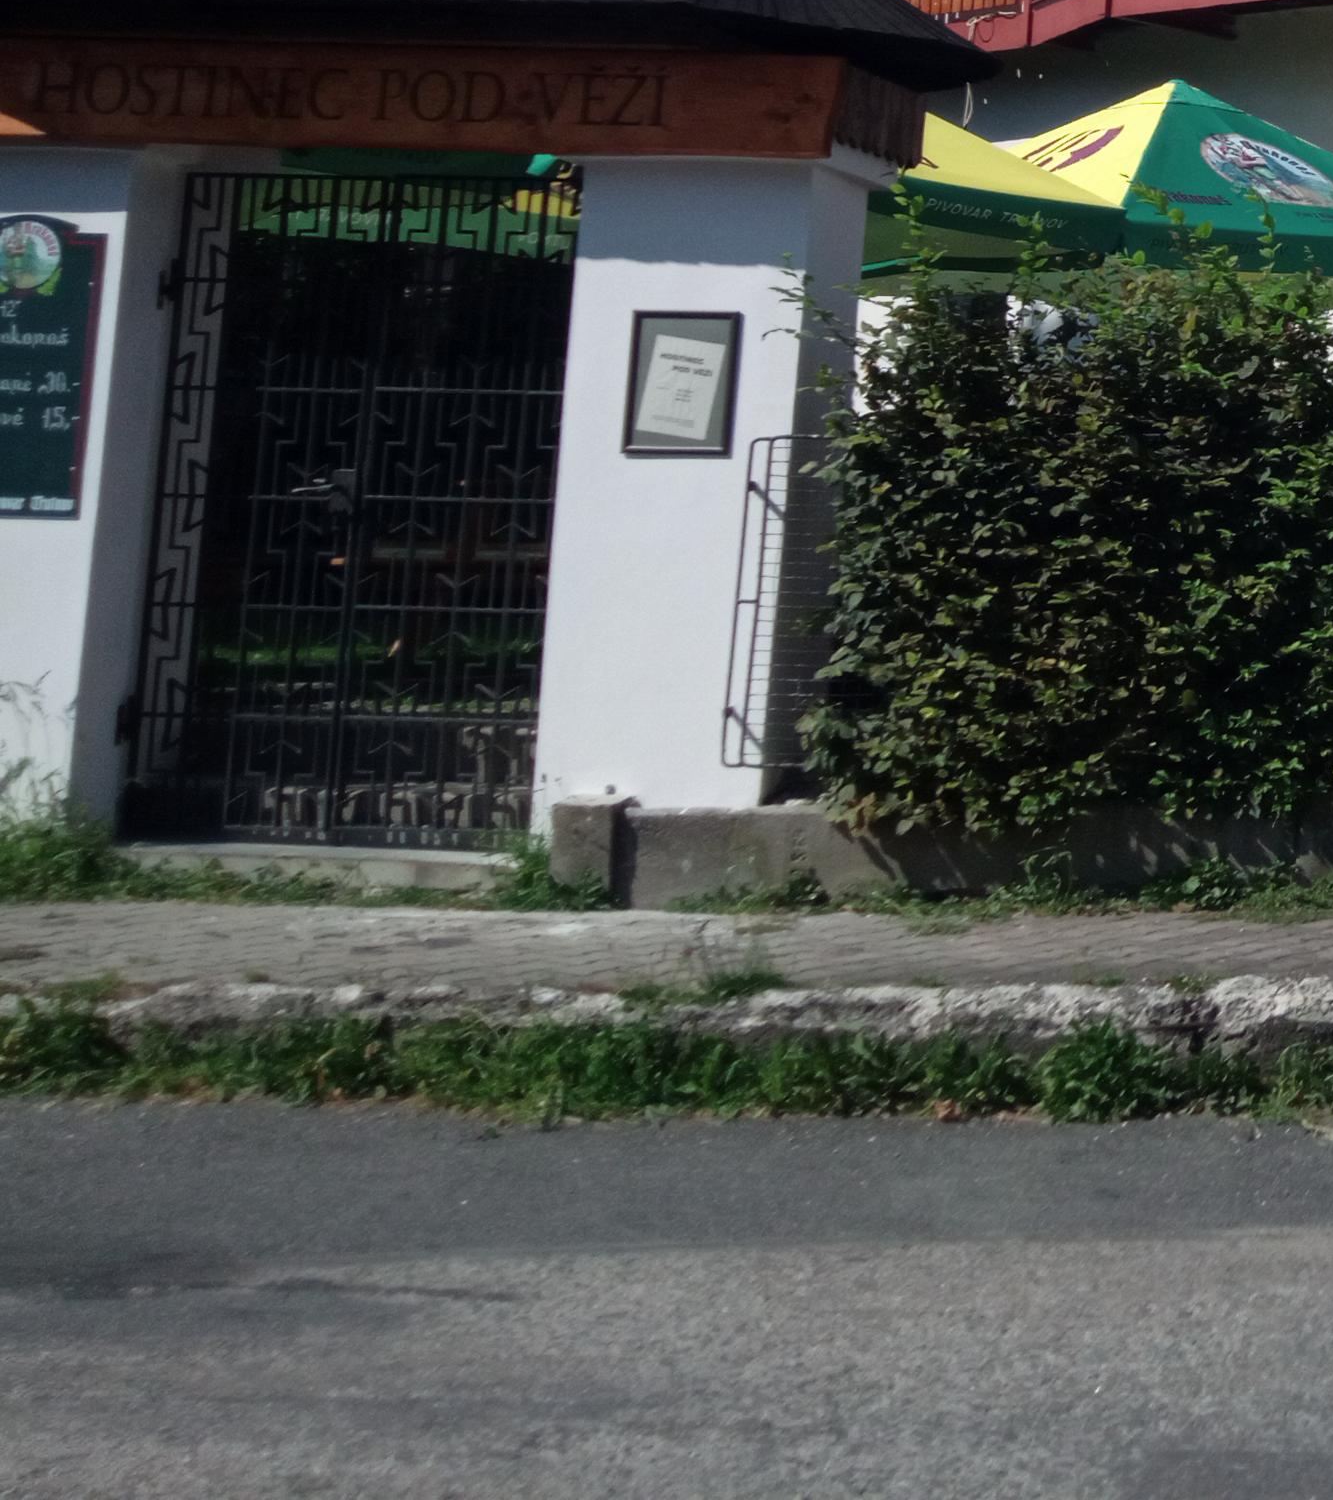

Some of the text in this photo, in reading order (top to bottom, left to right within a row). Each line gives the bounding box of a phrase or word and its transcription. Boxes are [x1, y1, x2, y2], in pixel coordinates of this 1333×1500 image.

[30, 59, 674, 127] HOSTINEC POD VĚŽÍ
[925, 197, 993, 220] PIVOVAR
